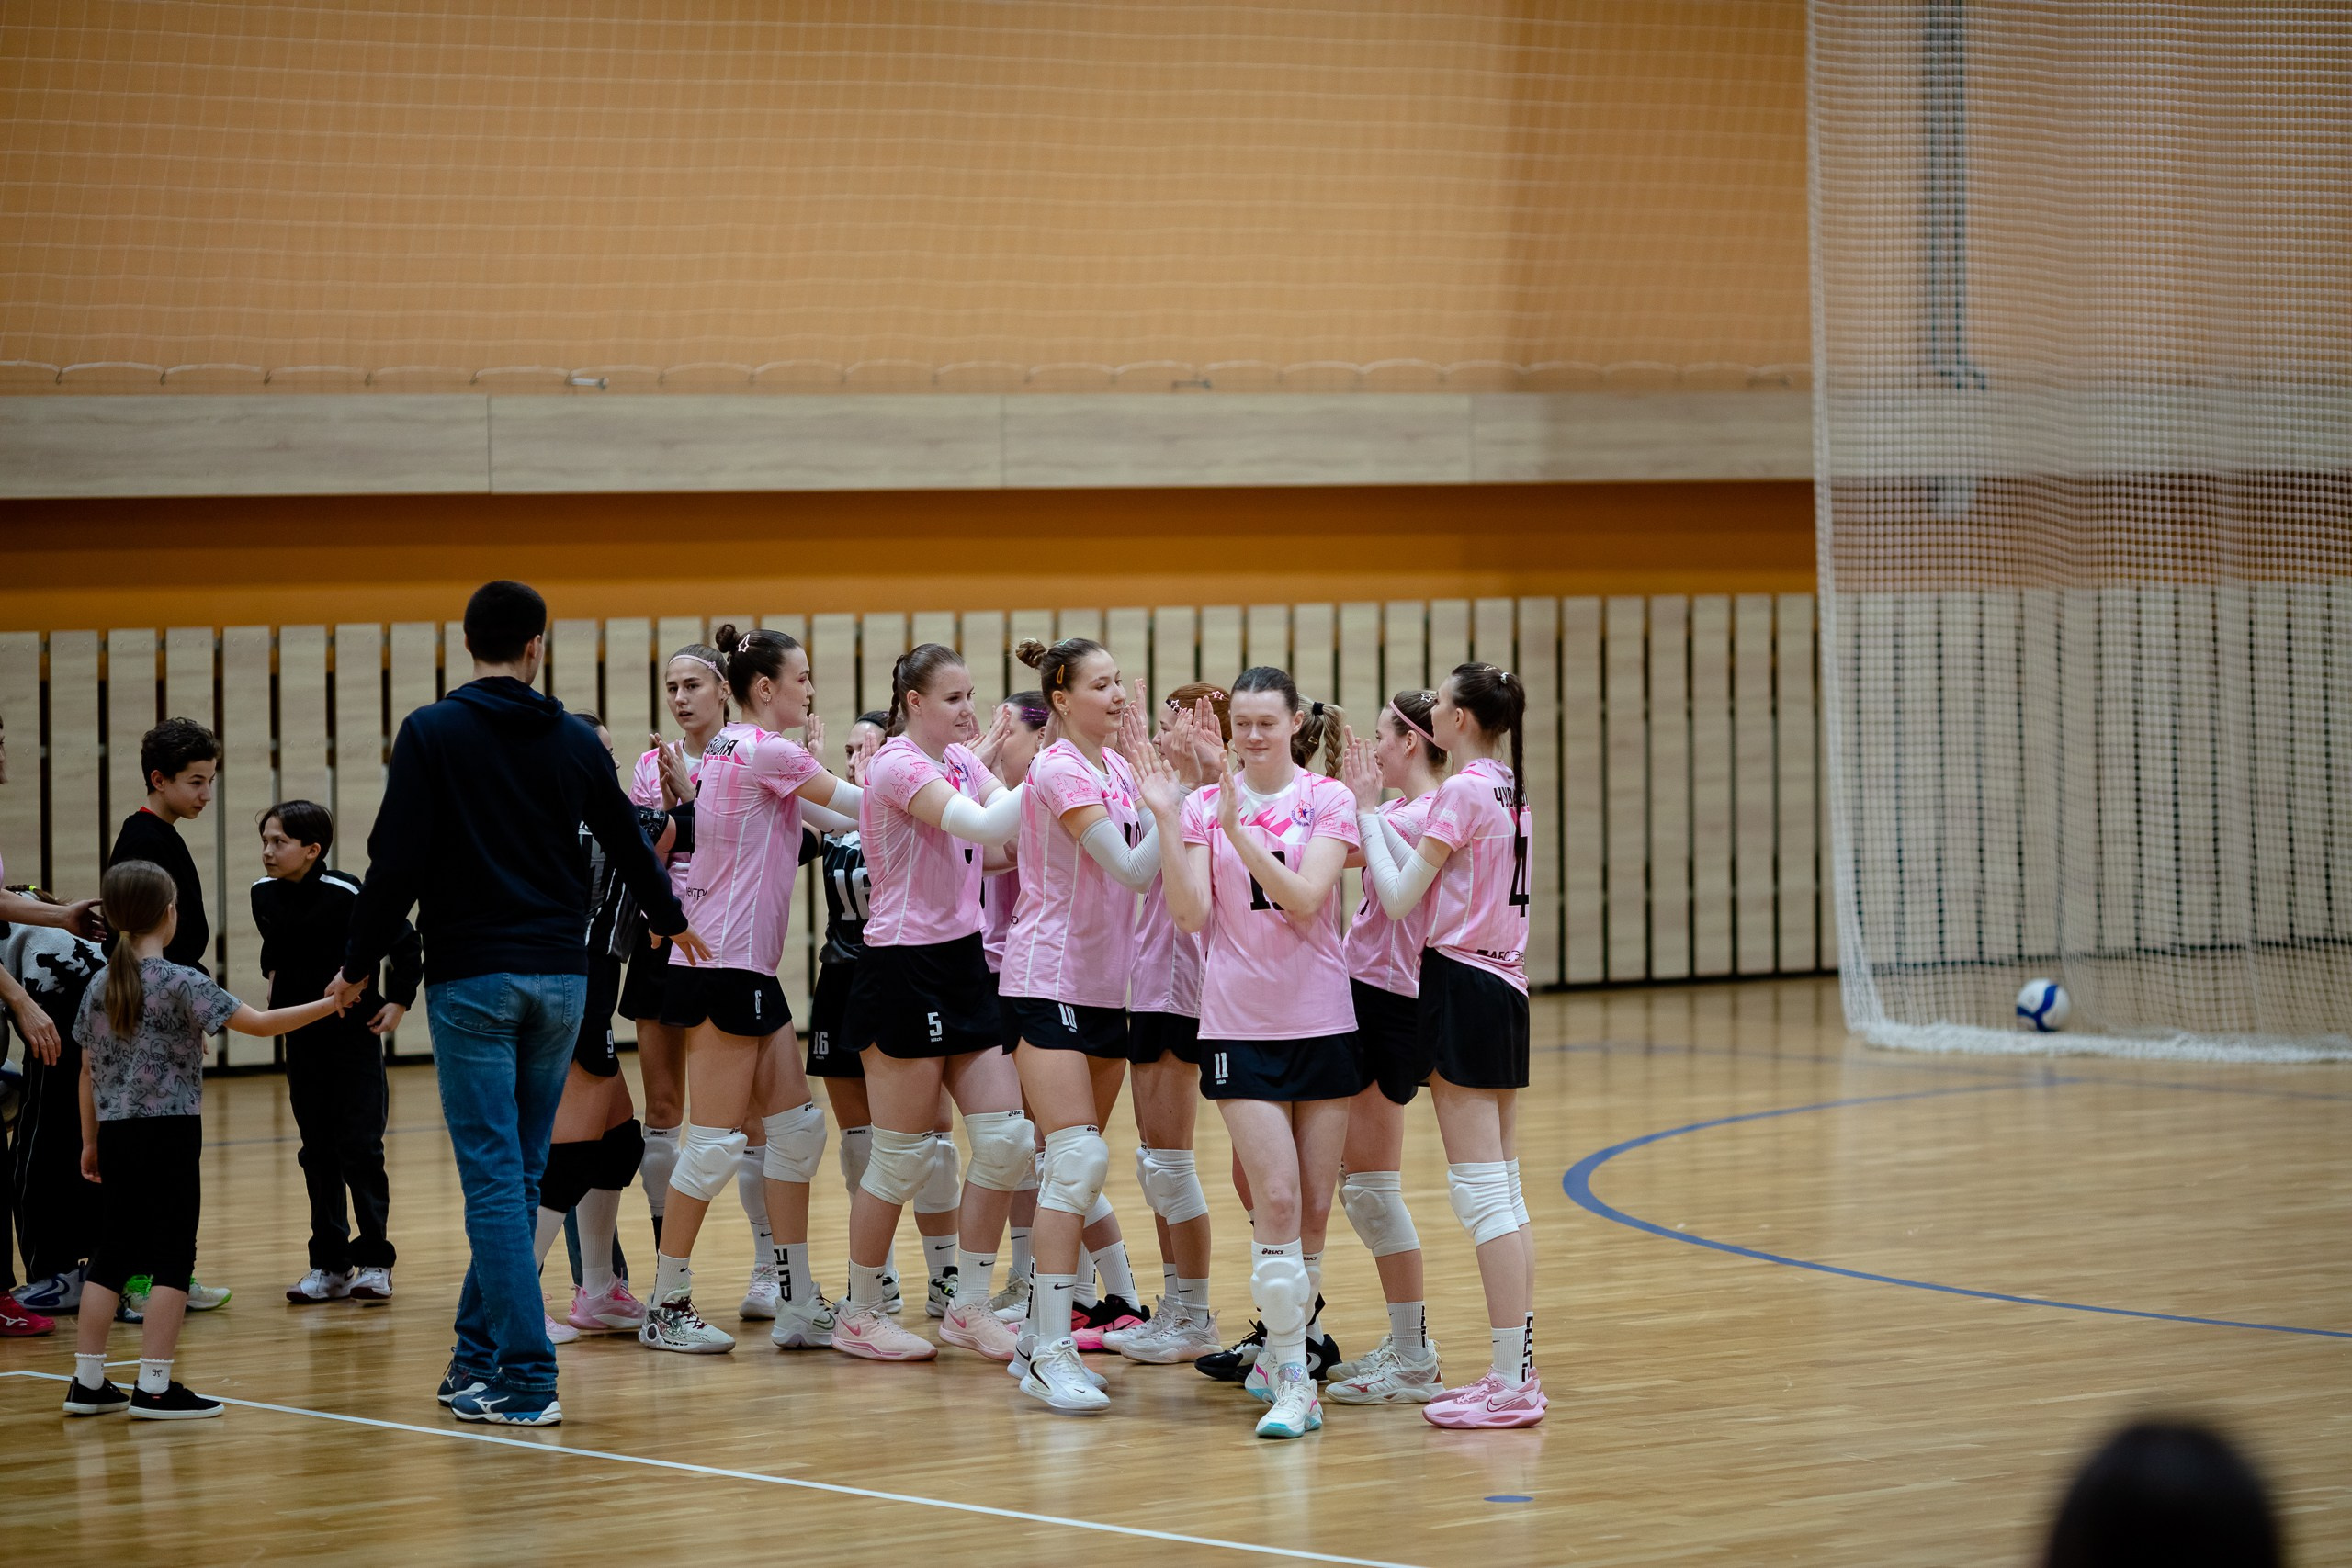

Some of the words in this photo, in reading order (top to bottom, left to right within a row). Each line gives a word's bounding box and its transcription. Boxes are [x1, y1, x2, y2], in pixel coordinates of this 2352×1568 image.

[1509, 836, 1530, 918] 4
[928, 1012, 943, 1036] 5
[1058, 1003, 1077, 1029] 10
[813, 1031, 829, 1055] 16
[1215, 1052, 1228, 1078] 11
